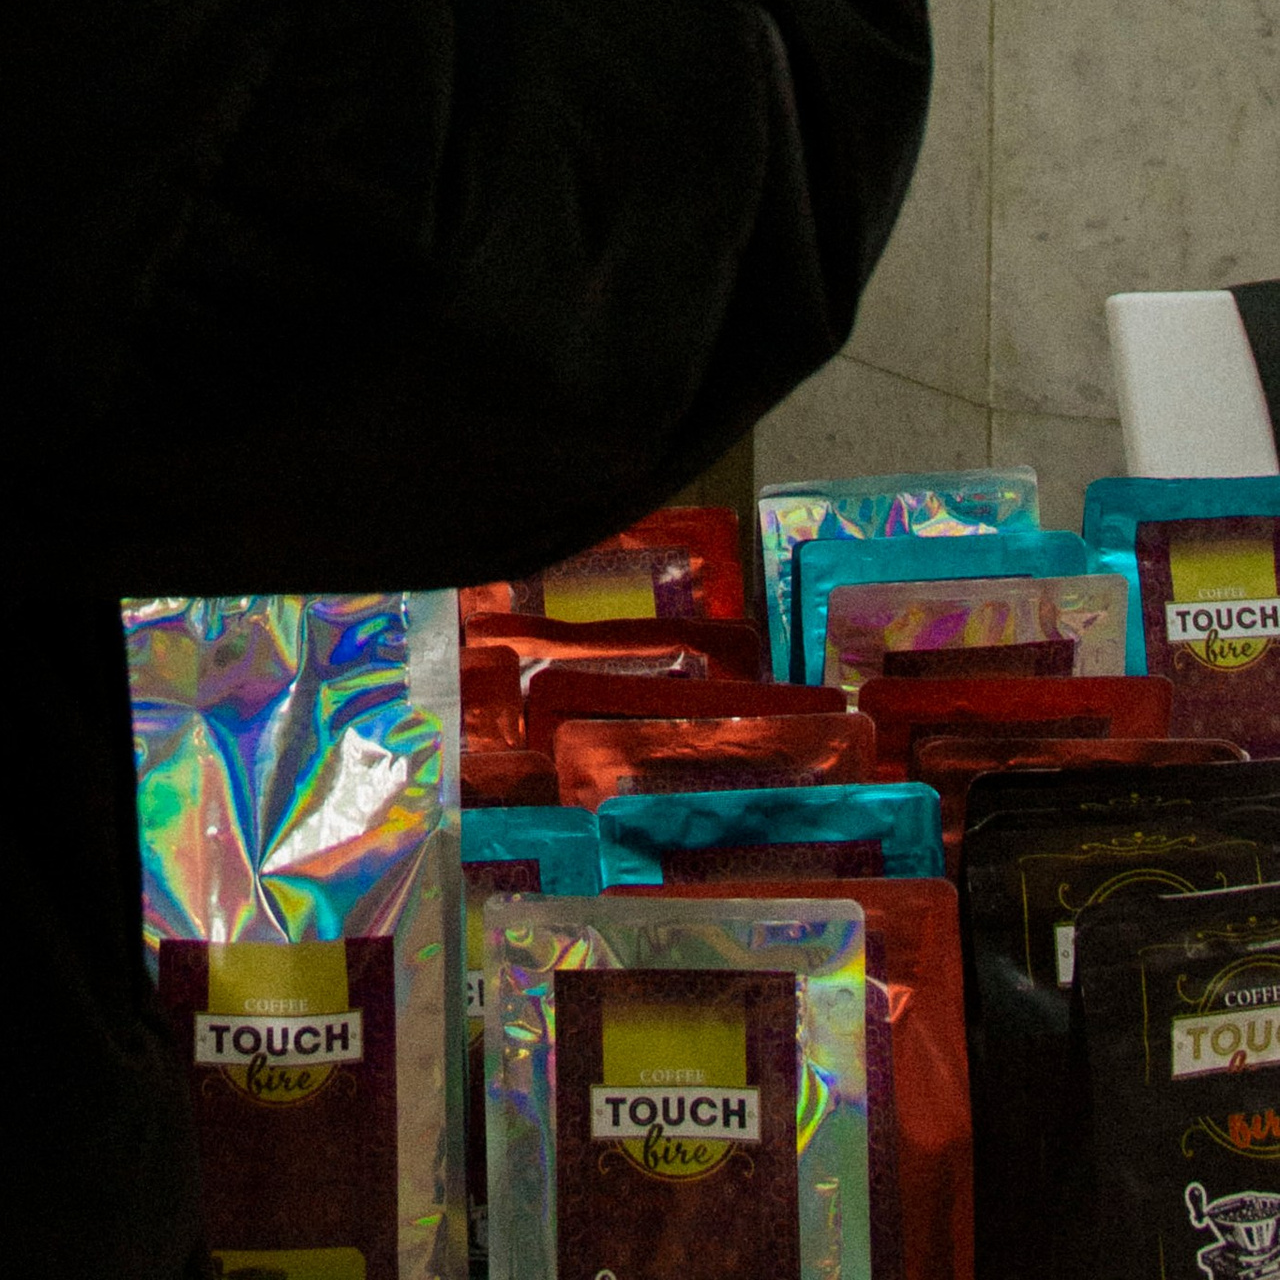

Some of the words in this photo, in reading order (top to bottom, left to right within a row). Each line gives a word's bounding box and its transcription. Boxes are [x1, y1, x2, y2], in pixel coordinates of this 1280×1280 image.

[1198, 587, 1246, 599] COFFEE
[1175, 606, 1280, 632] TOUCH
[1205, 628, 1253, 664] fire
[243, 998, 309, 1012] COFFEE
[208, 1022, 349, 1056] TOUCH
[1186, 1019, 1280, 1060] TOU
[246, 1052, 313, 1098] fire
[639, 1068, 707, 1083] COFFEE
[605, 1096, 747, 1128] TOUCH
[643, 1123, 715, 1170] fire
